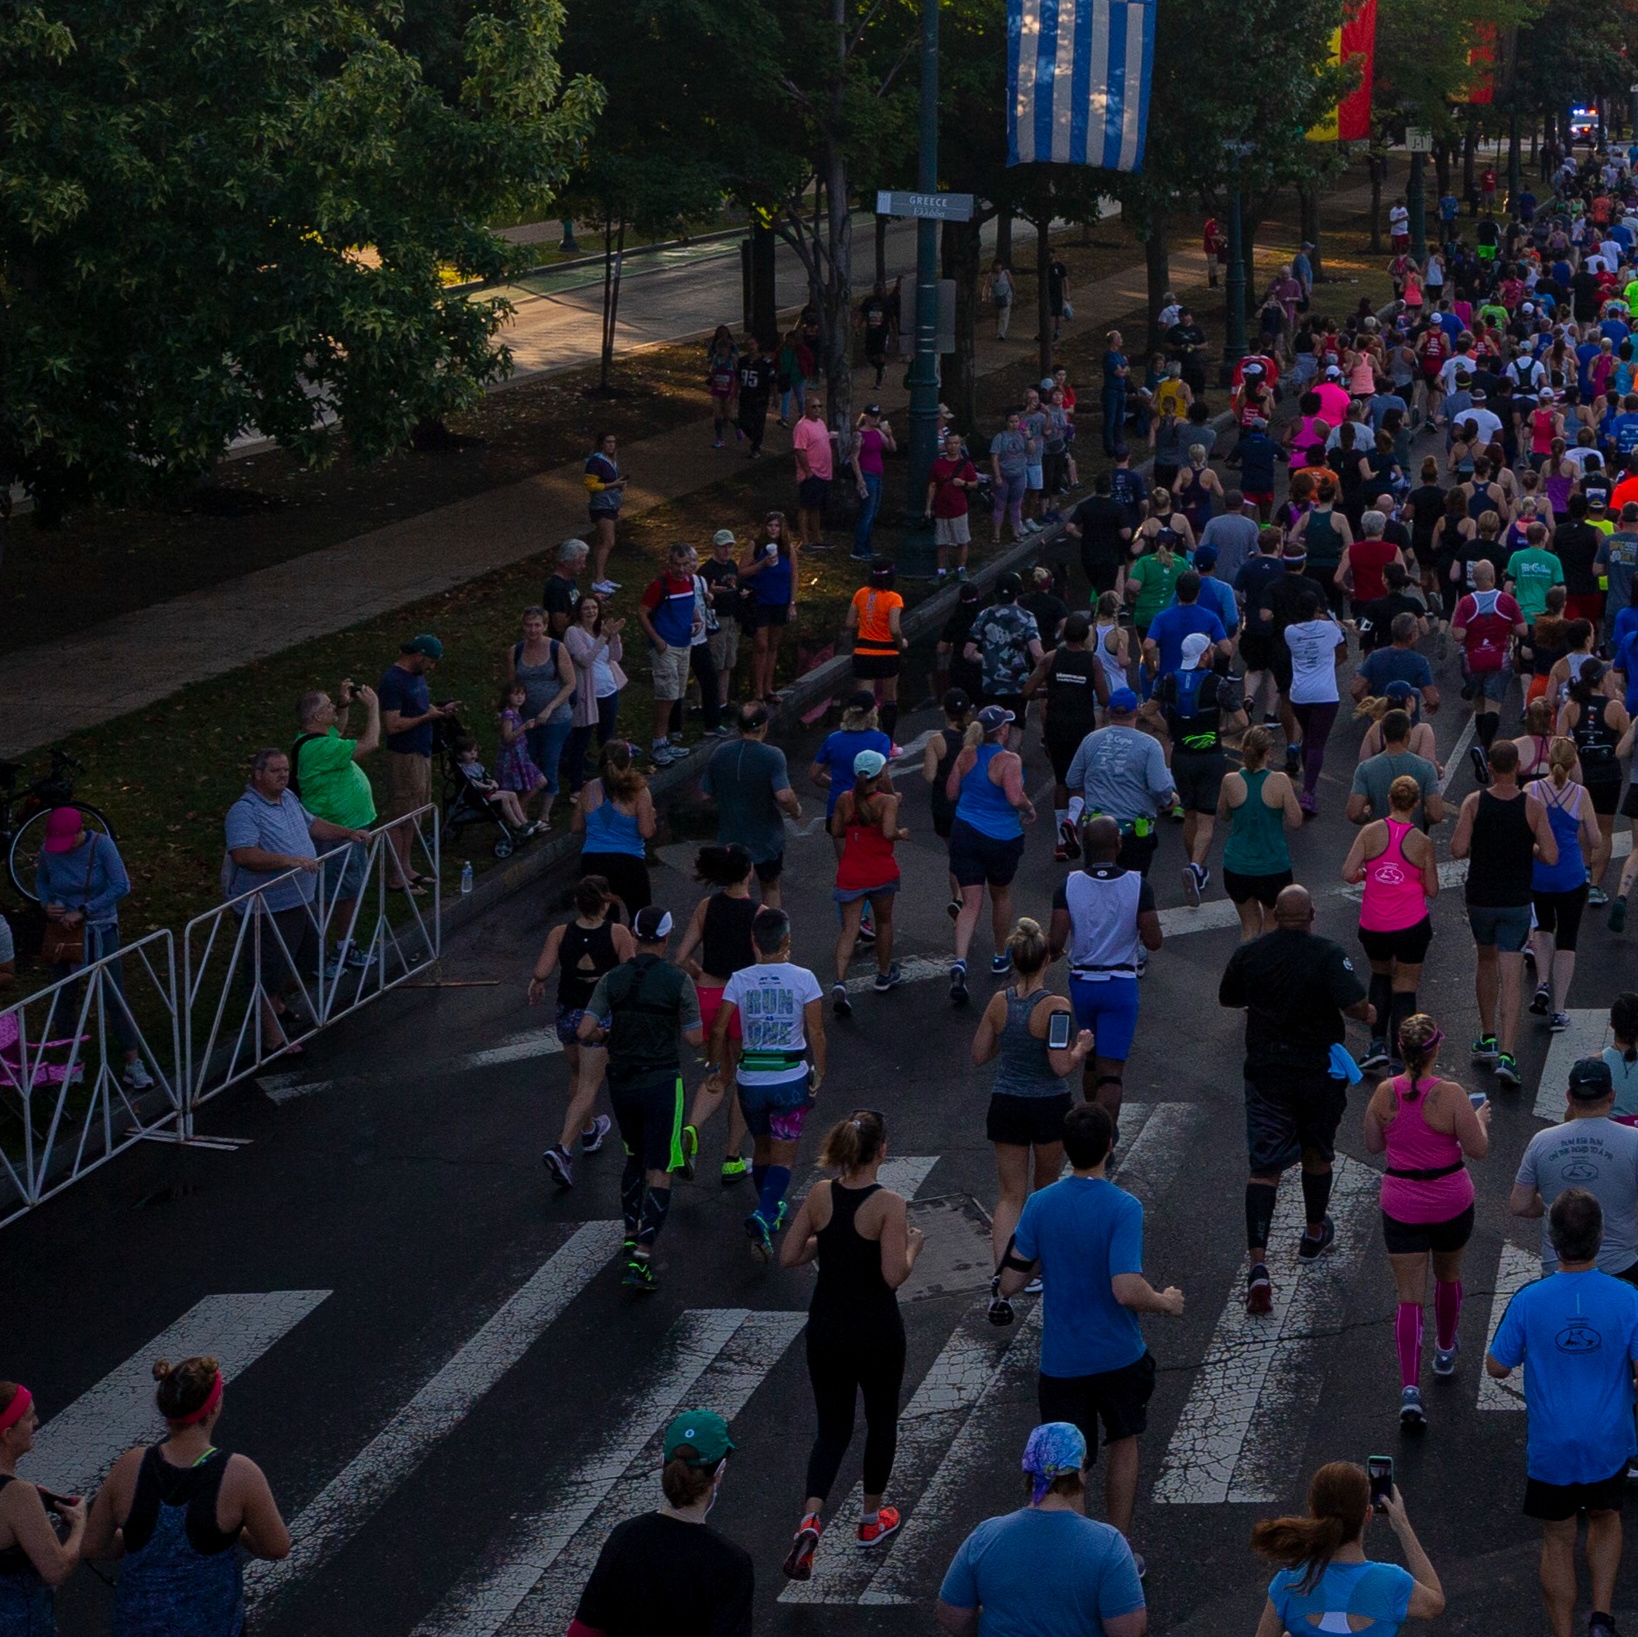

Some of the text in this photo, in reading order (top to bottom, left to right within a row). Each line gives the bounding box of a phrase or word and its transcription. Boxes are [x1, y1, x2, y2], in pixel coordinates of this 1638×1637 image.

[909, 196, 948, 207] GREECE
[741, 369, 759, 388] 95
[746, 988, 794, 1015] RUN
[747, 1021, 793, 1046] ONE
